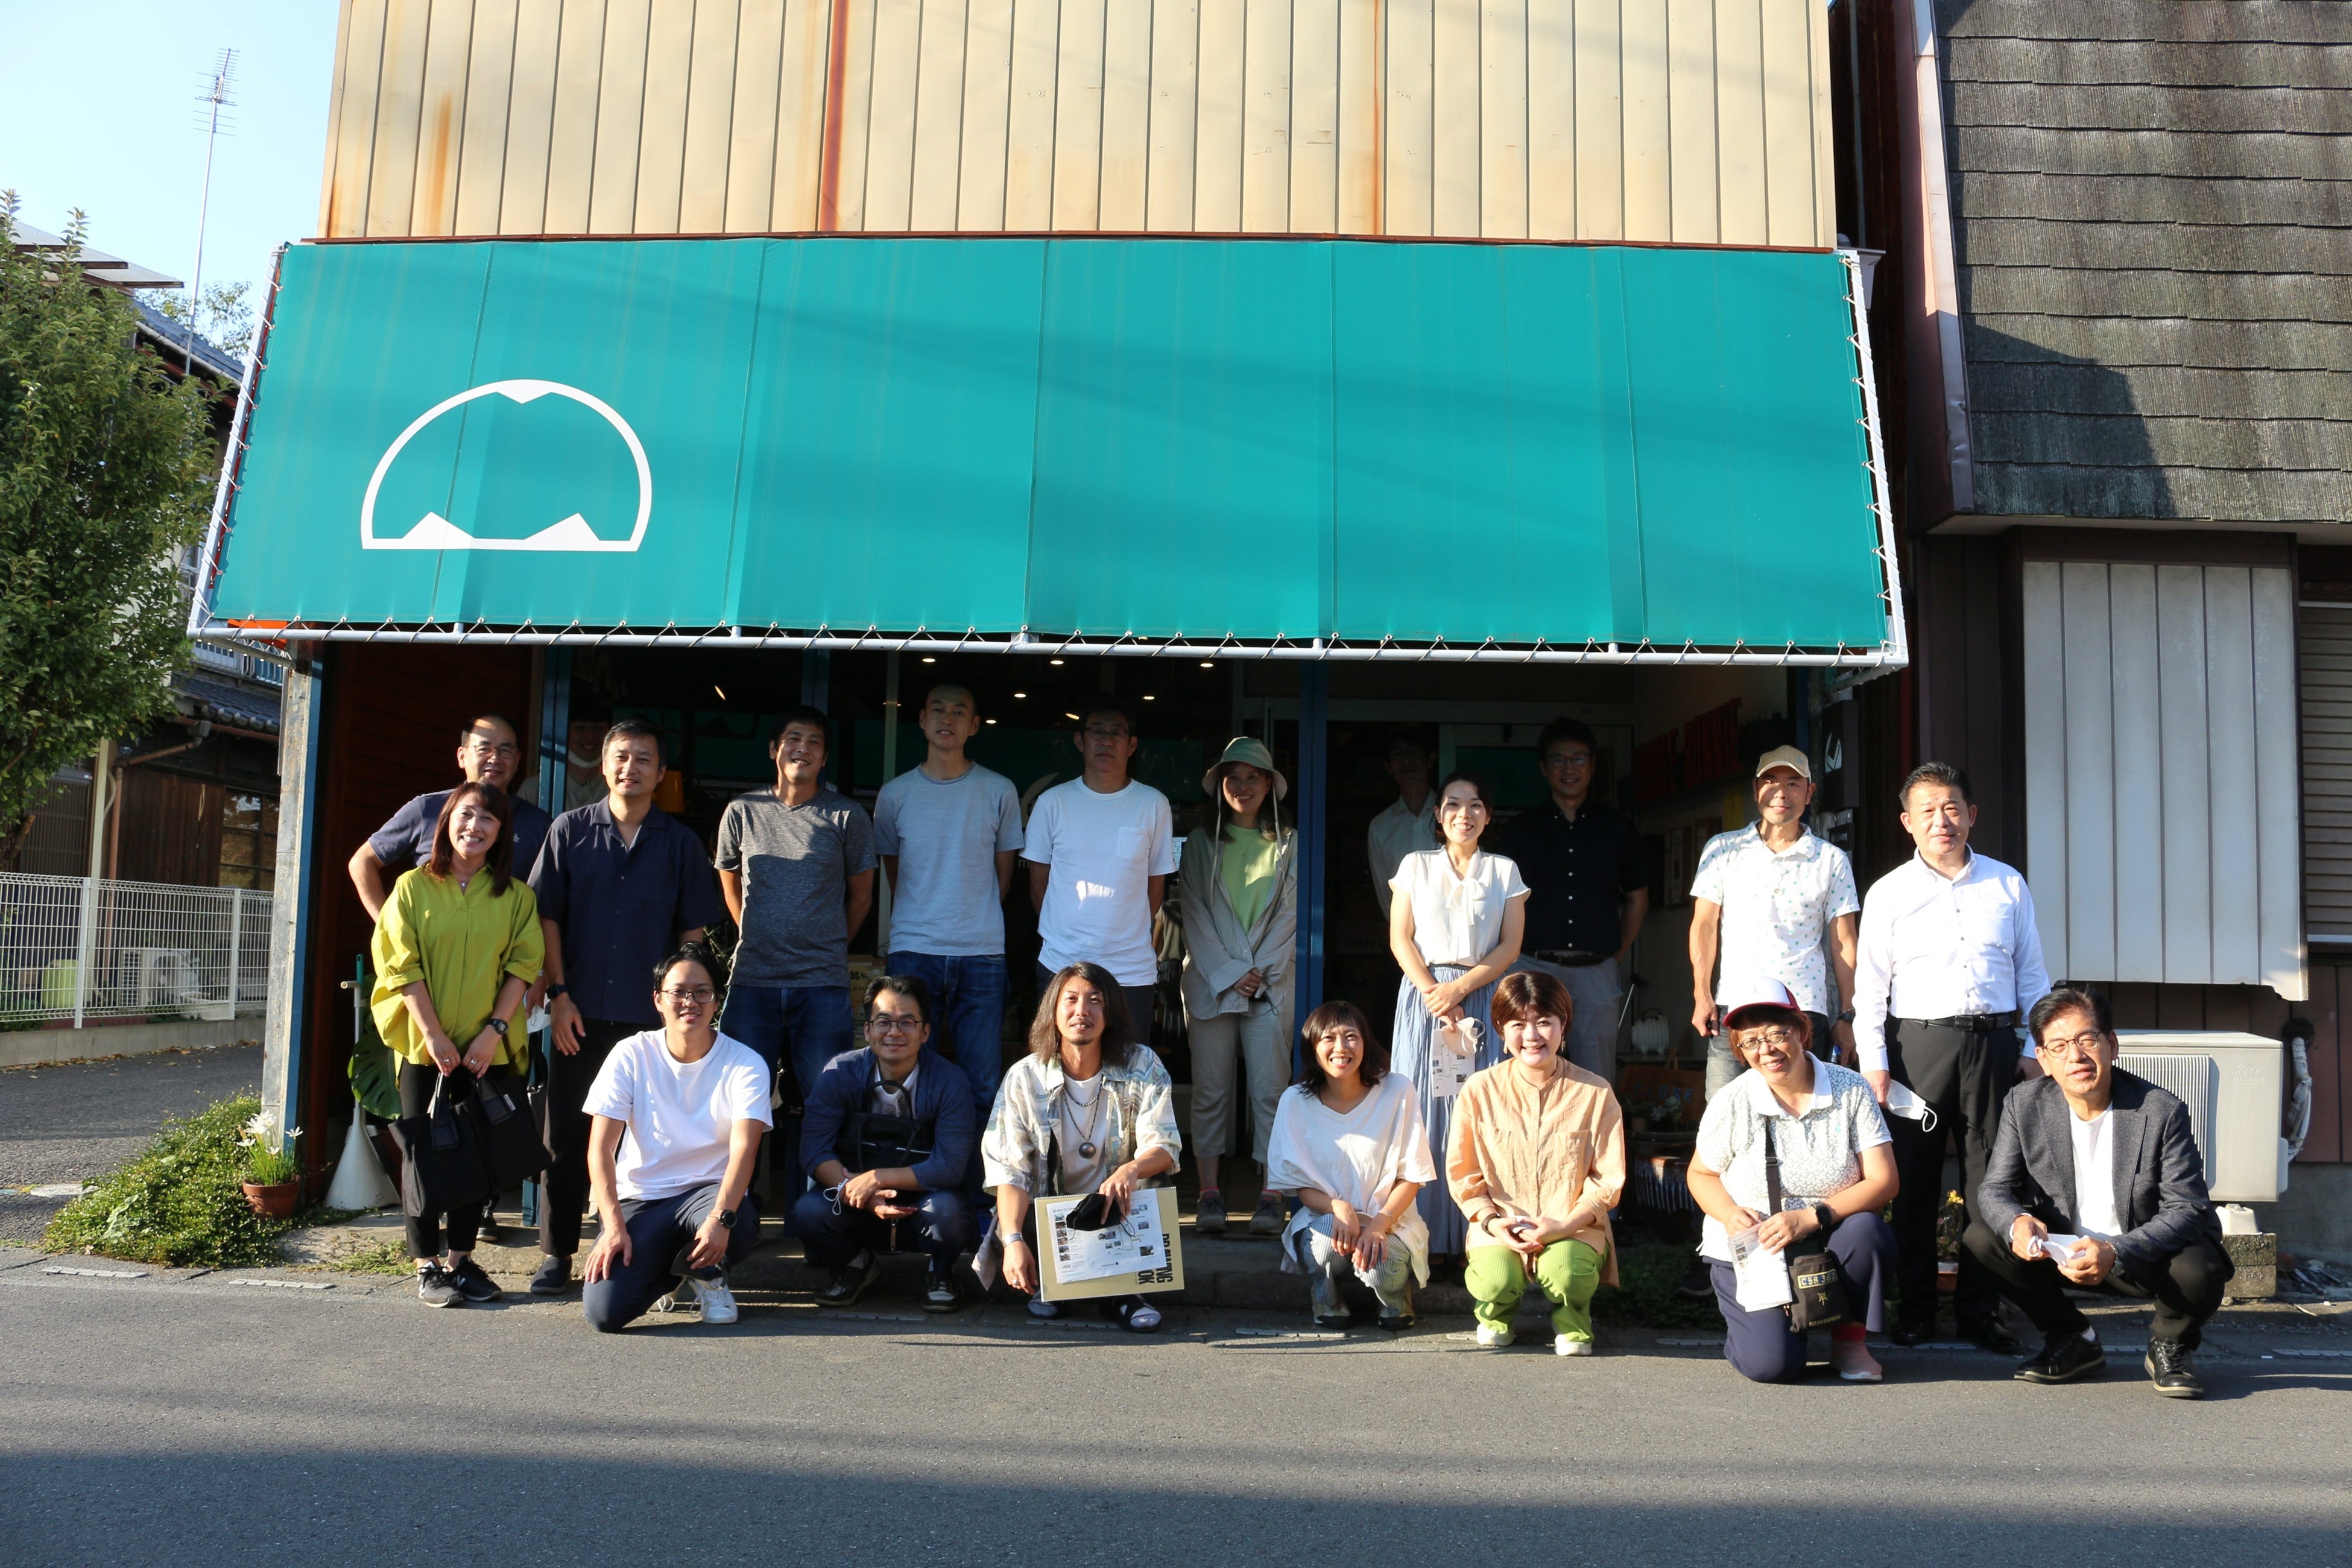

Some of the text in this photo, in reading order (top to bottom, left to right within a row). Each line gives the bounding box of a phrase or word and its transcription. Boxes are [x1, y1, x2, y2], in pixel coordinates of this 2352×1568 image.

[1633, 1080, 1695, 1103] CLOSE
[1138, 1269, 1155, 1285] OK
[1801, 1272, 1835, 1286] C58 363
